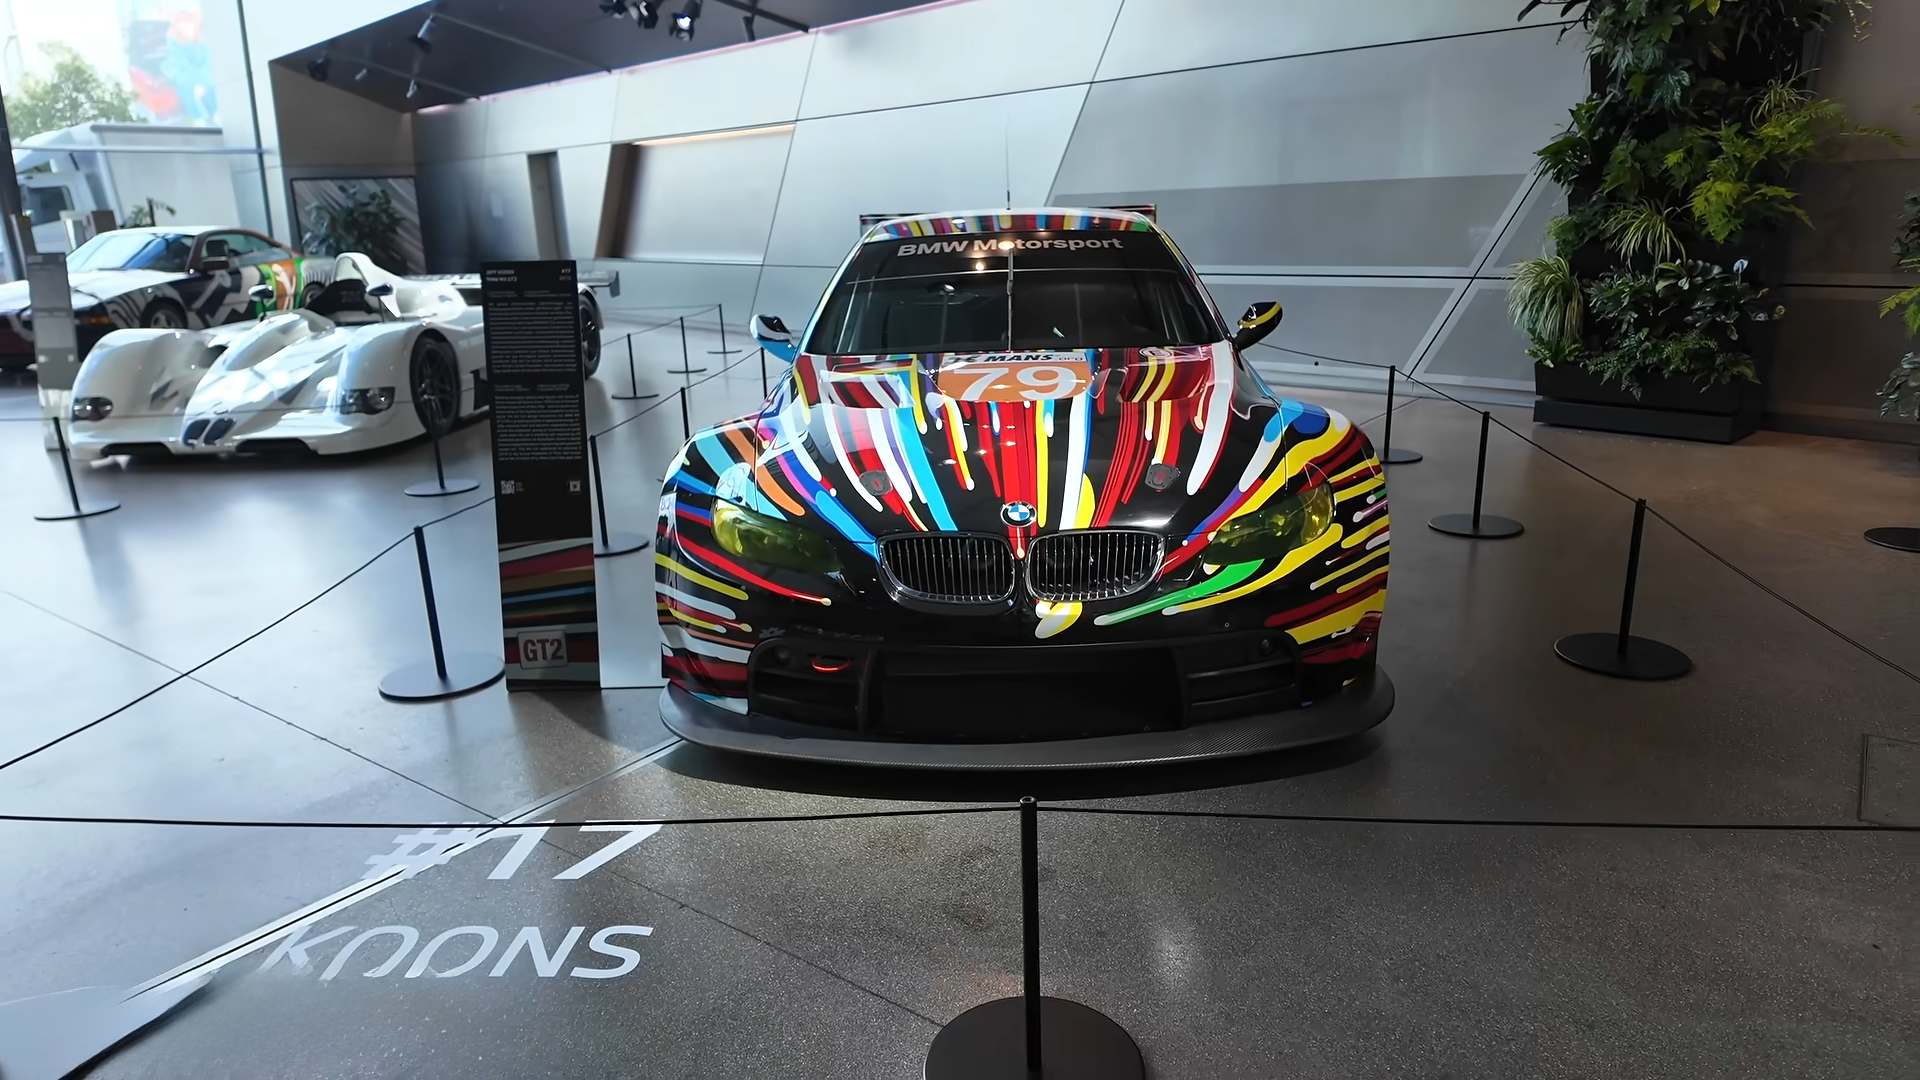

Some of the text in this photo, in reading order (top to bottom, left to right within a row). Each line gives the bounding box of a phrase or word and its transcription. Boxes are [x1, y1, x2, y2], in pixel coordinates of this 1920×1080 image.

[897, 237, 1124, 257] BMW Motorsport
[983, 354, 1054, 362] MANS
[953, 365, 1077, 401] 79
[523, 638, 564, 662] GT2
[360, 819, 665, 880] #17
[254, 925, 654, 980] KOONS
